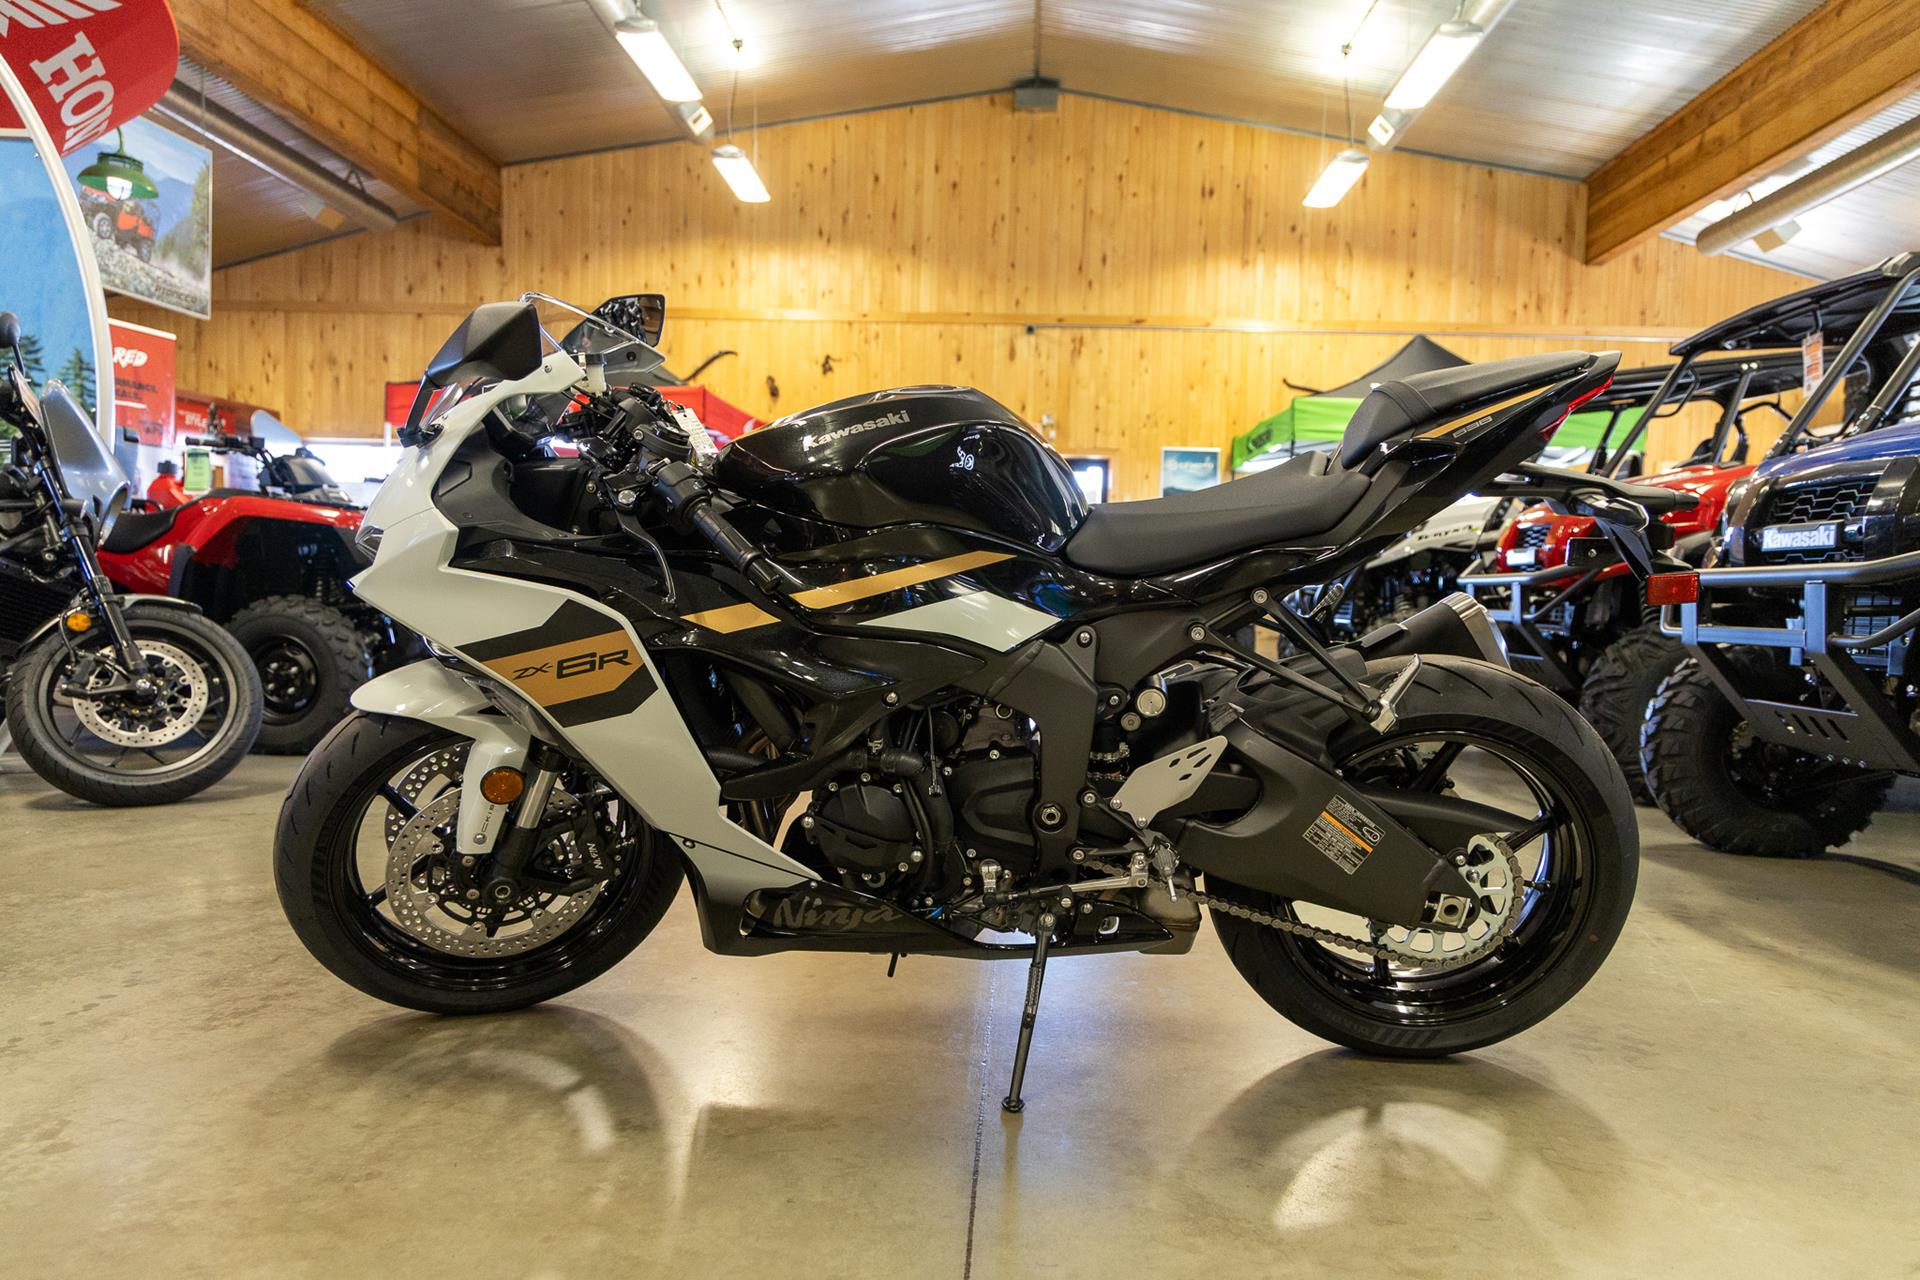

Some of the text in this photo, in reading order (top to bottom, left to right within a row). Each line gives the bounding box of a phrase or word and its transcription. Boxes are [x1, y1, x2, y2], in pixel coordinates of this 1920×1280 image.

[112, 346, 149, 368] RED
[803, 410, 911, 452] Kawasaki
[1763, 524, 1836, 549] Kawasaki
[773, 896, 903, 931] Ninja
